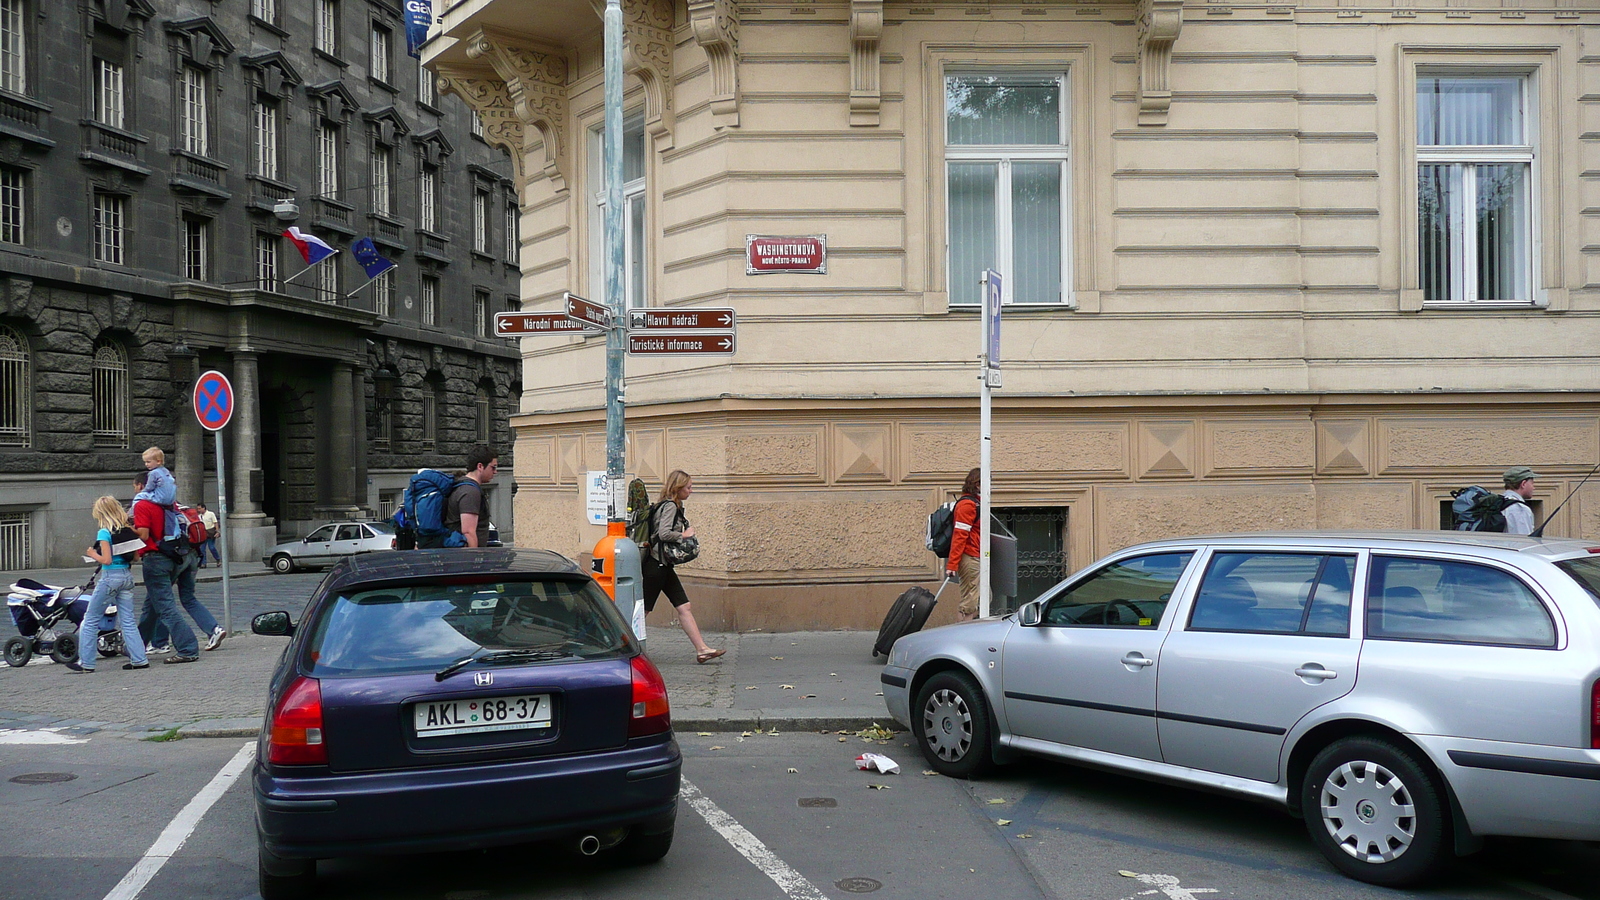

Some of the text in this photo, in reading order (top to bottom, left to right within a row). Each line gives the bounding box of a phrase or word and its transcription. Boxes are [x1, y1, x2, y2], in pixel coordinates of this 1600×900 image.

[757, 244, 816, 255] WASHINGTONOVA
[761, 256, 774, 264] NOVÉ
[991, 283, 999, 336] P
[523, 317, 551, 330] Národní
[647, 314, 698, 326] Hlavní nádraží
[631, 339, 703, 350] Turistické informace
[426, 697, 541, 727] AKL 68-37
